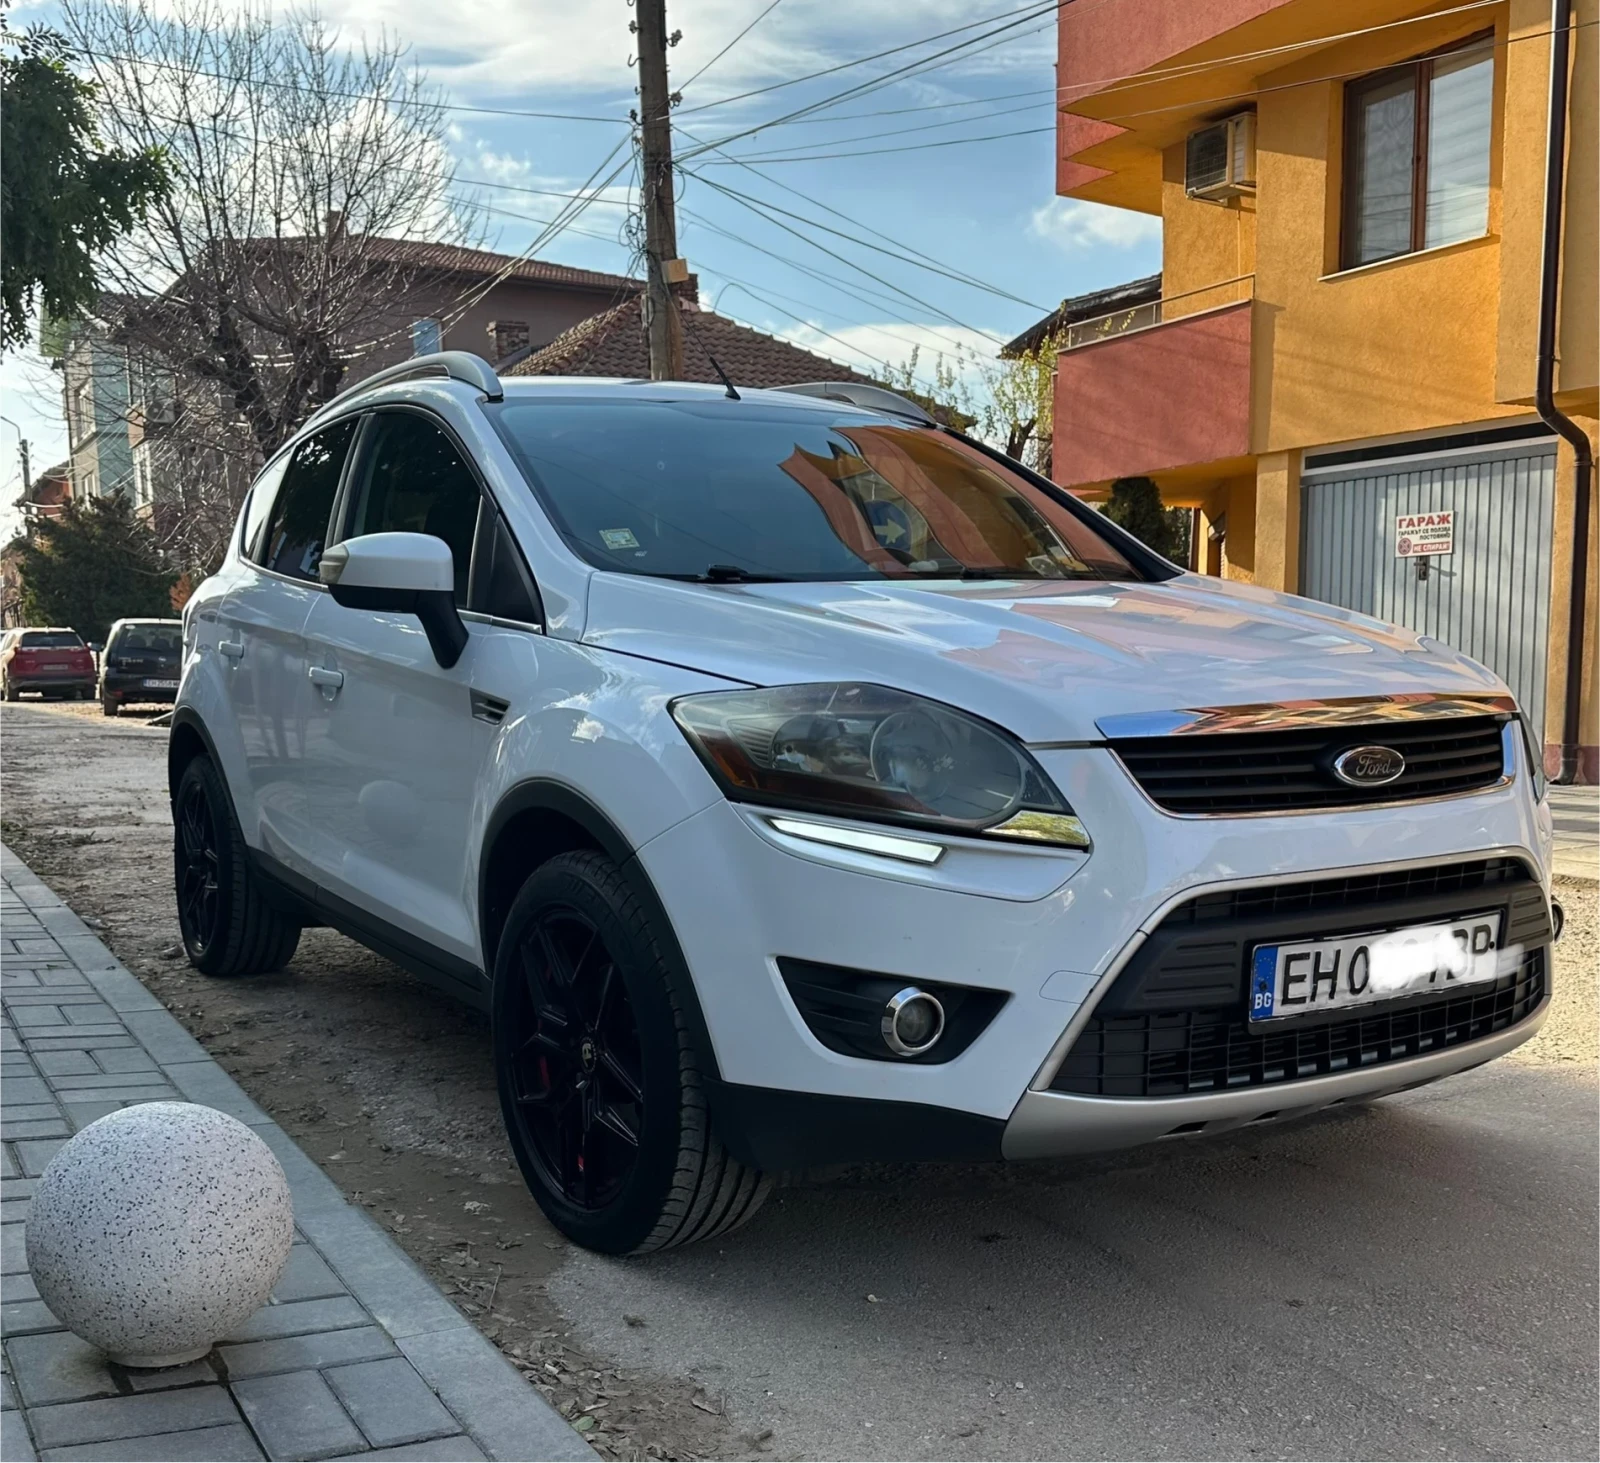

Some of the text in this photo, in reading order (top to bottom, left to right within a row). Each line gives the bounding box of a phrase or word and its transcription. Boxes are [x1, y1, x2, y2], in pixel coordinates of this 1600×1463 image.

[1398, 513, 1451, 529] ГАРАЖ
[1356, 754, 1394, 776] Ford
[1254, 992, 1272, 1009] BG
